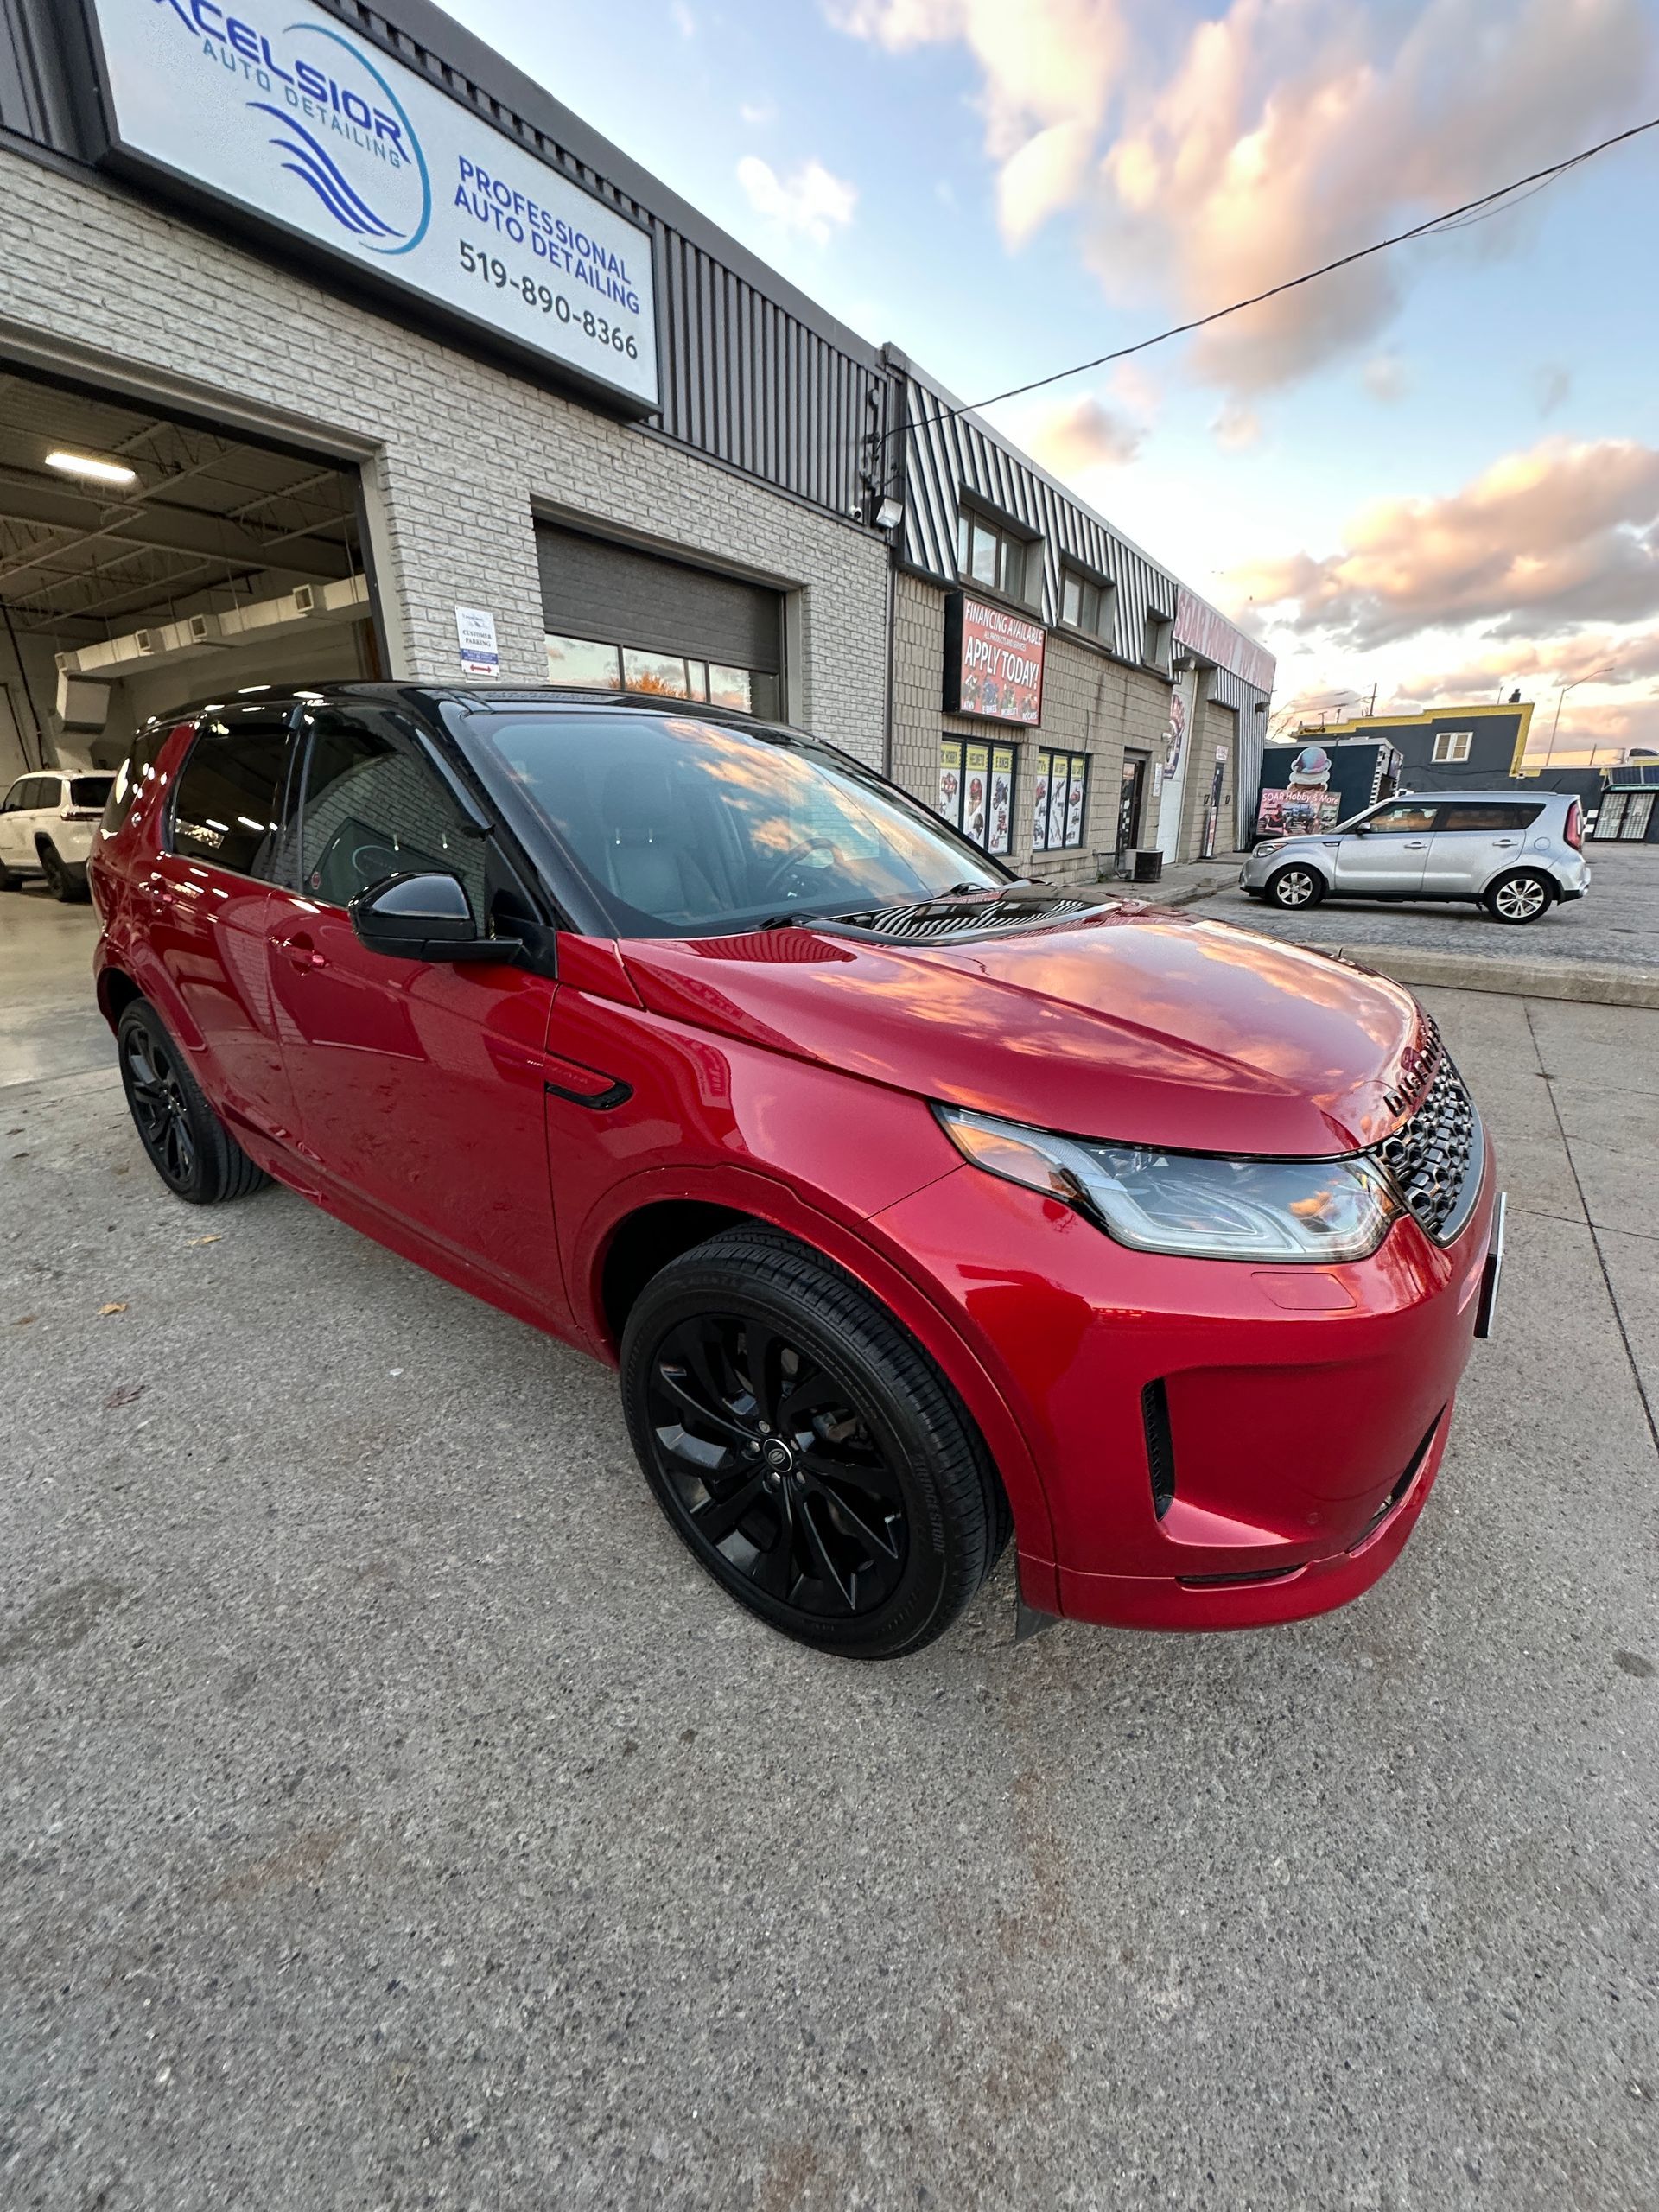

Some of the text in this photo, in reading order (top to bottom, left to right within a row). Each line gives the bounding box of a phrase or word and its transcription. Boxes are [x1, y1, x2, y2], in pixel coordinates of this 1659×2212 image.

[202, 38, 401, 168] AUTO DETAILING
[459, 155, 632, 285] PROFESSIONAL
[454, 184, 640, 315] AUTO DETAILING
[460, 238, 639, 359] 519-890-8366
[462, 629, 493, 639] CUSTOMER
[465, 638, 491, 647] PARKING
[964, 601, 1044, 646] FINANCING AVAILABLE
[964, 635, 1039, 690] APPLY TODAY!
[1262, 792, 1284, 802] SOAR
[1284, 791, 1311, 803] Hobby
[1319, 794, 1339, 804] More
